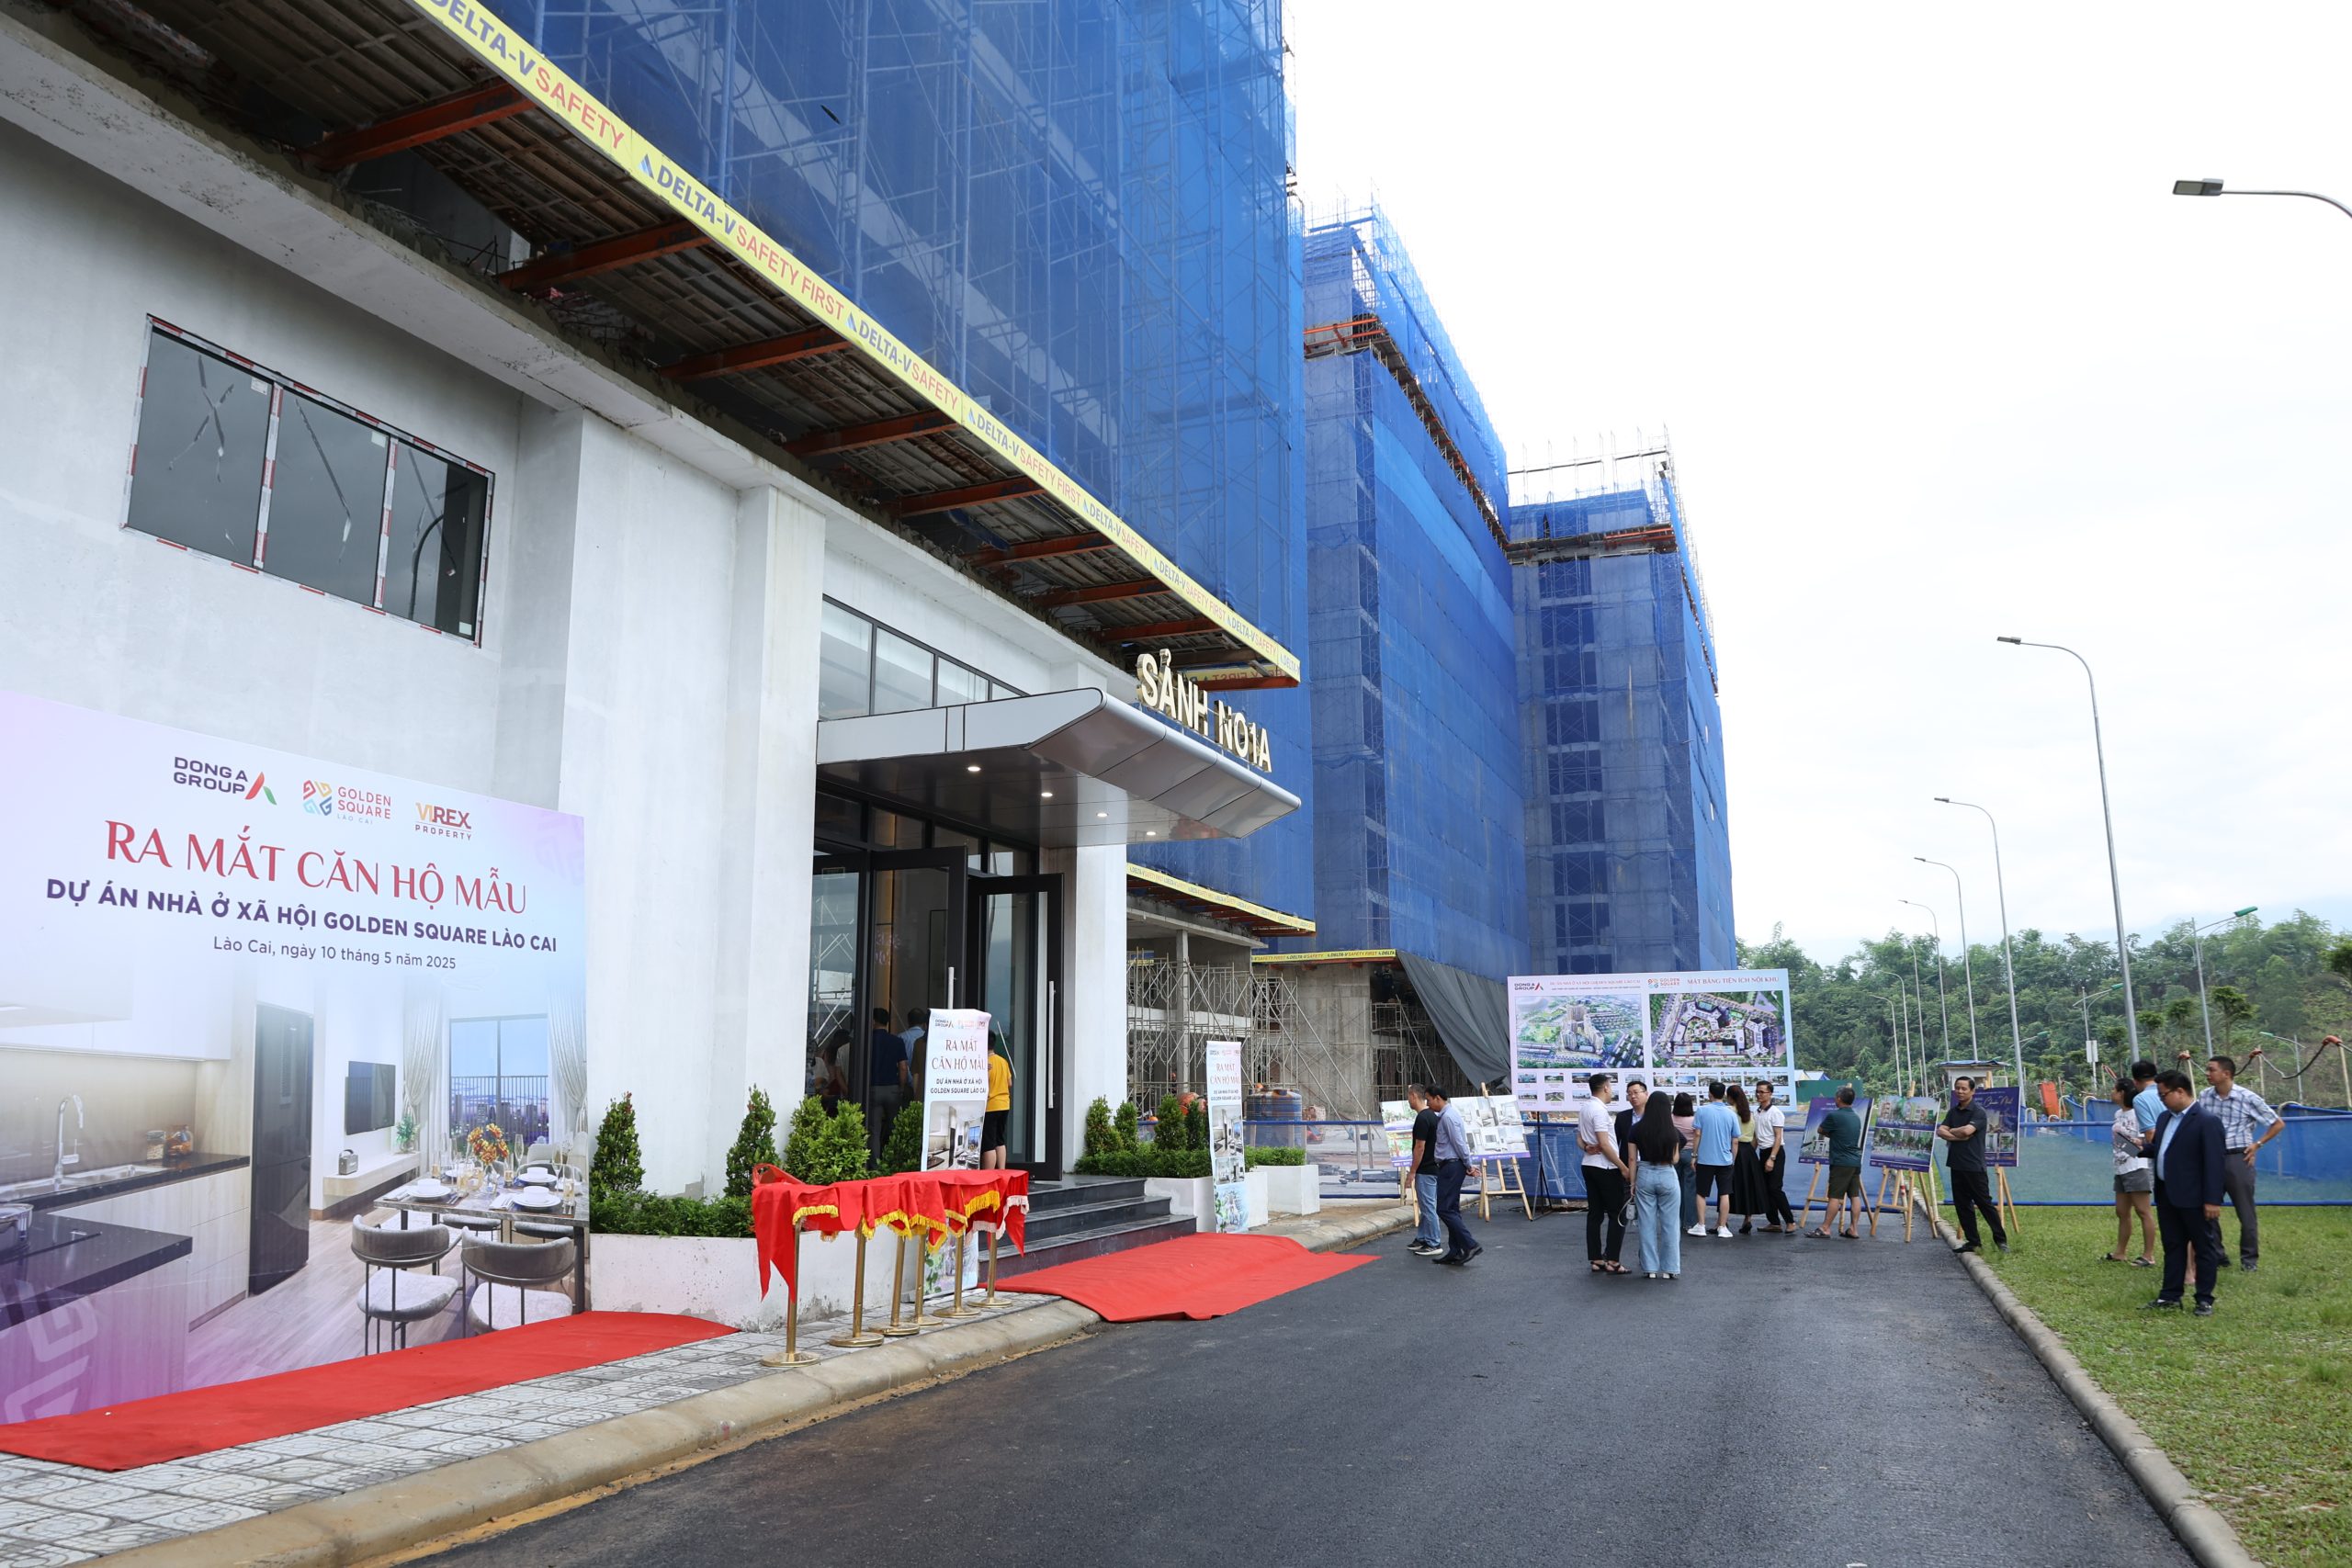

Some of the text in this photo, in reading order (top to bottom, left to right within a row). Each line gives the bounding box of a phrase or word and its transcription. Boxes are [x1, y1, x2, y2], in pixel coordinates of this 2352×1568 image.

[536, 66, 625, 150] SAFETY
[657, 165, 844, 321] DELTA-V SAFETY FIRST
[858, 319, 958, 411] DELTA-V SAFETY
[977, 413, 1081, 506] DELTA-V SAFETY FIRST
[1090, 502, 1148, 562] DELTA-V SAFETY
[1159, 559, 1186, 590] DELTA-V
[1136, 648, 1209, 737] SẢNH
[173, 772, 246, 794] GROUP
[175, 756, 248, 782] DONG A
[337, 786, 391, 807] GOLDEN
[337, 799, 391, 819] SQUARE
[415, 802, 472, 829] VIREX
[414, 824, 472, 840] PROPERTY
[105, 820, 526, 914] RA MẮT CĂN HỘ MẪU
[46, 878, 557, 952] DỰ ÁN NHÀ Ở XÃ HỘI GOLDEN SQUARE LÀO CAI
[213, 936, 457, 969] Lào Cai, ngày 10 tháng 5 năm 2025
[945, 1036, 978, 1052] RA MẮT
[932, 1055, 953, 1070] CĂN
[954, 1055, 967, 1072] HỘ
